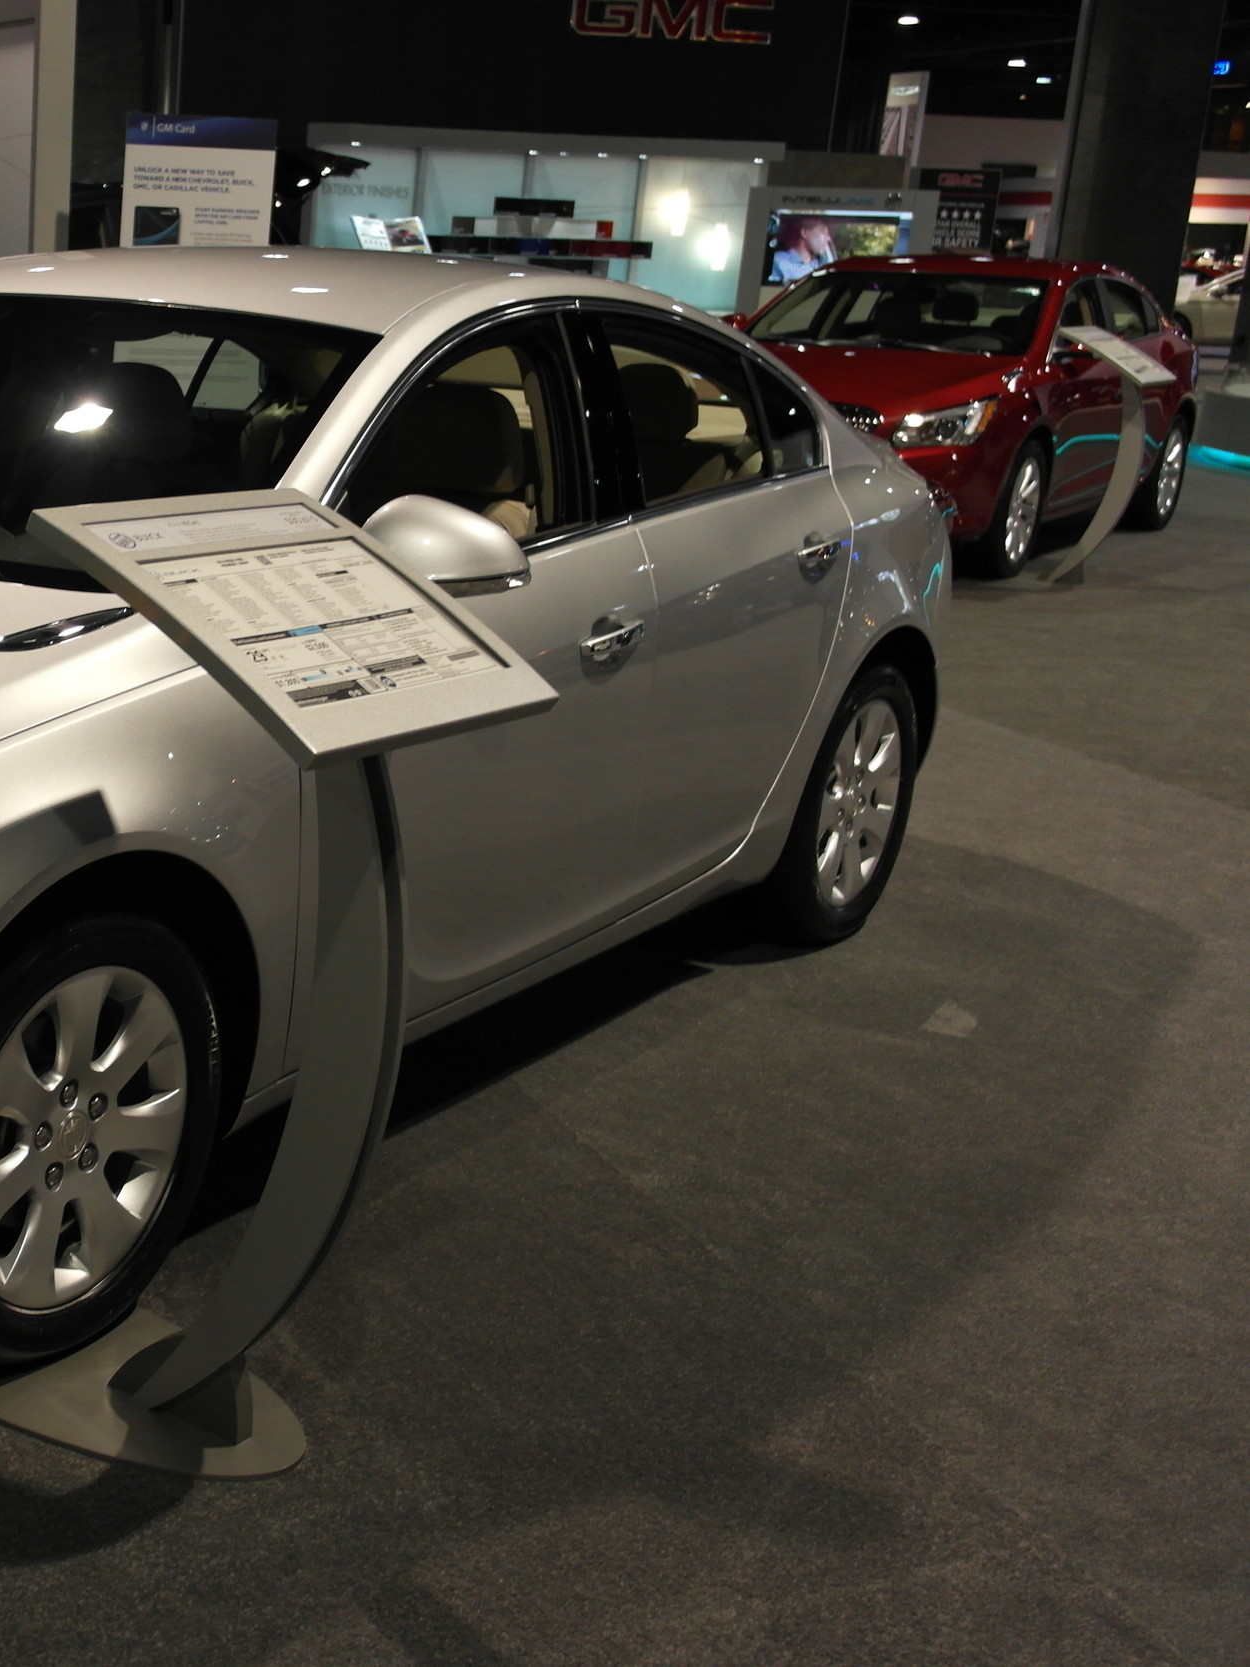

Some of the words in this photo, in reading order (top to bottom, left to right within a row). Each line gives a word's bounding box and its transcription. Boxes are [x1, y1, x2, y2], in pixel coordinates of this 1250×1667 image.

[570, 0, 774, 45] GMC
[156, 122, 174, 133] GM
[174, 123, 196, 134] Card
[133, 166, 162, 174] UNLOCK
[134, 174, 164, 182] TOWARD
[187, 177, 229, 186] CHEVROLET,
[231, 179, 255, 187] BUICK,
[937, 172, 984, 188] GMC
[132, 183, 150, 191] GMC,
[164, 184, 198, 192] CADILLAC
[321, 182, 364, 196] EXTERIOR
[366, 185, 410, 199] FINISHES
